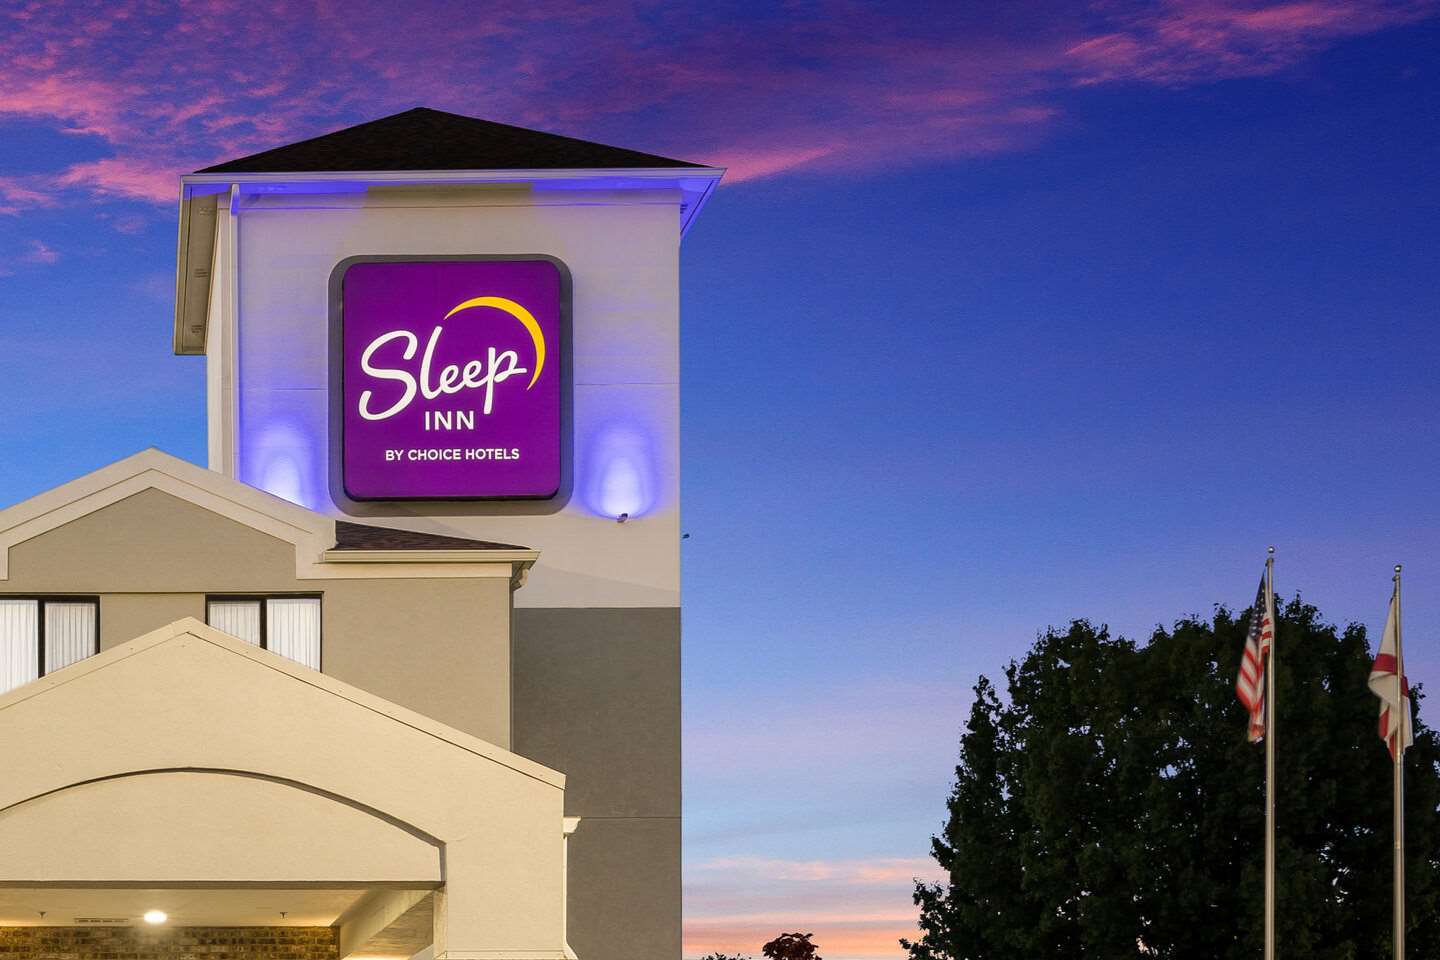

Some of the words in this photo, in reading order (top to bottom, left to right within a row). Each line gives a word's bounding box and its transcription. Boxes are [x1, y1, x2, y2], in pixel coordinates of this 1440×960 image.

[358, 325, 528, 421] Sleep
[424, 410, 475, 431] INN
[385, 449, 404, 461] BY
[407, 448, 462, 461] CHOICE
[465, 447, 520, 460] HOTELS
